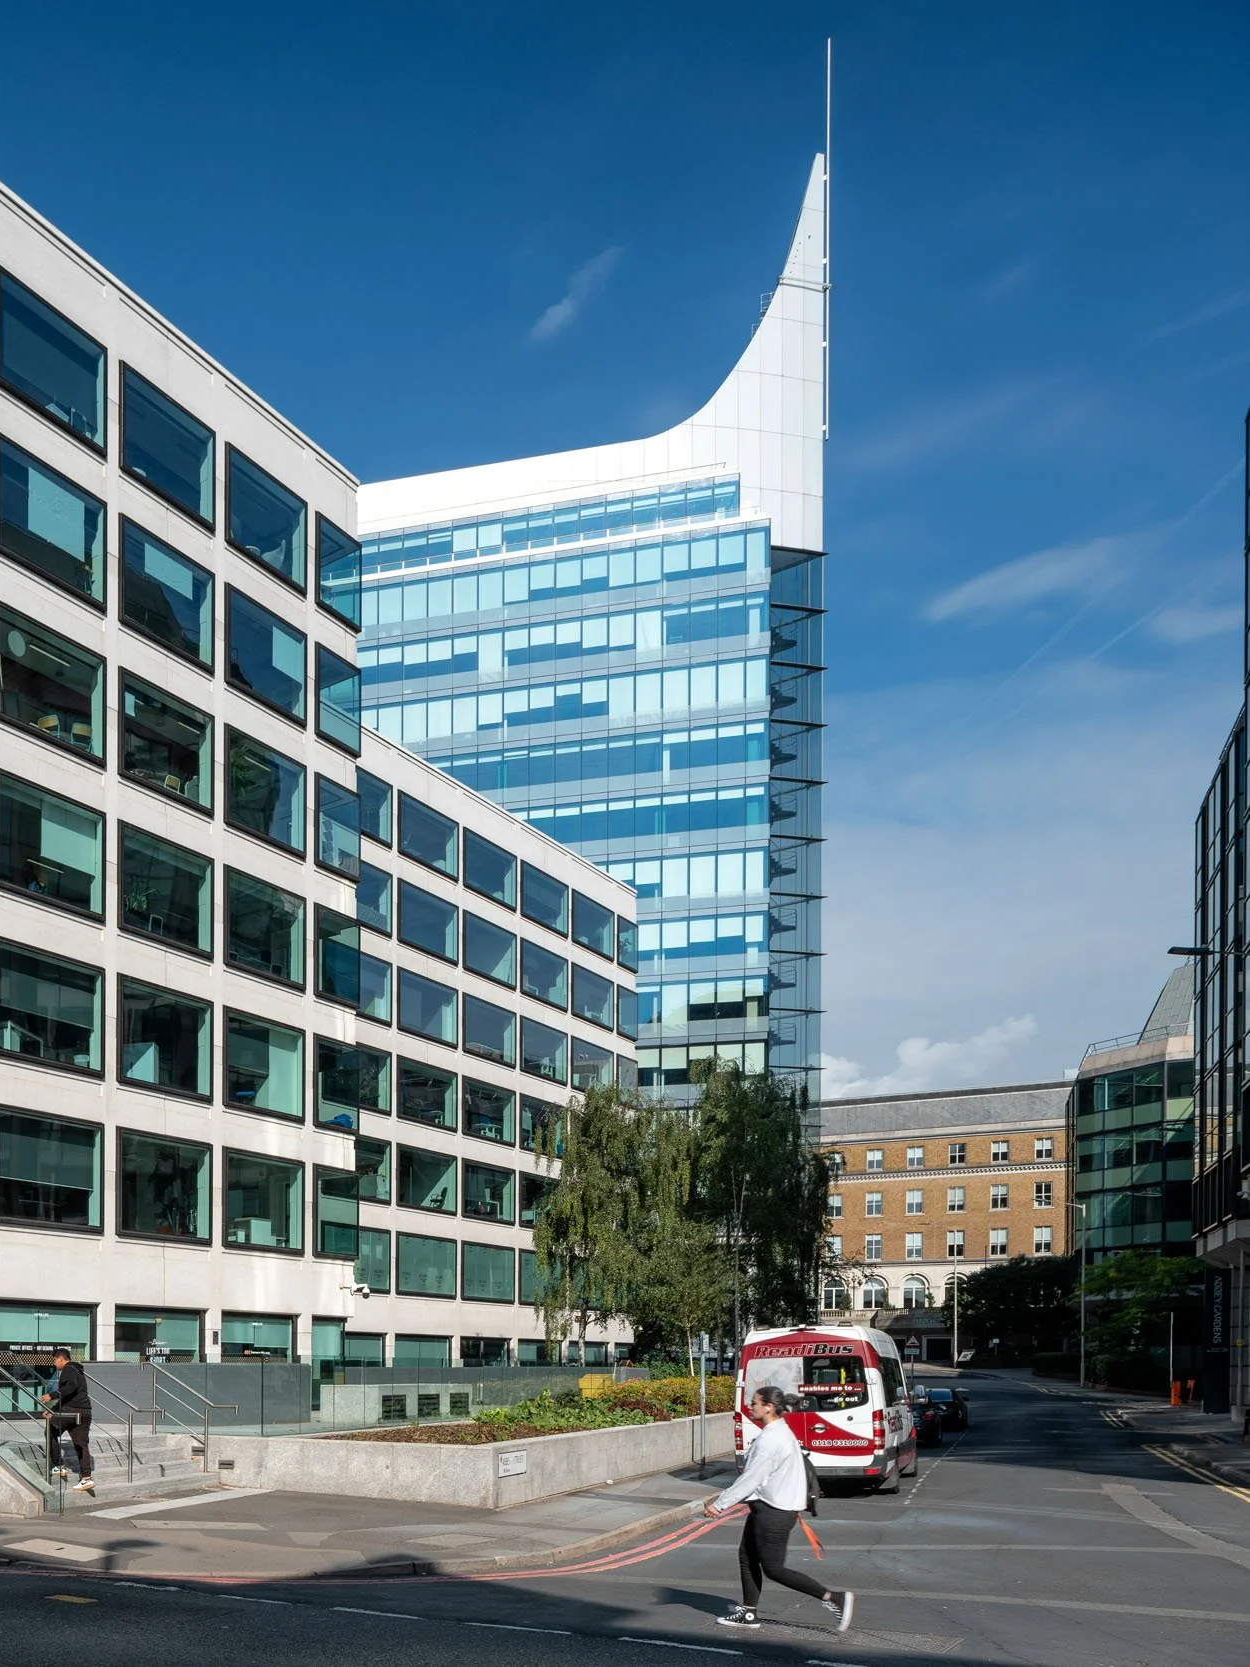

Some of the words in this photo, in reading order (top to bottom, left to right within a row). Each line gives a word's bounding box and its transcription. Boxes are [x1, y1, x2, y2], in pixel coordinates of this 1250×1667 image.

[1213, 1304, 1223, 1344] GARDENS
[754, 1342, 854, 1358] ReadiBus
[812, 1438, 833, 1447] 0118
